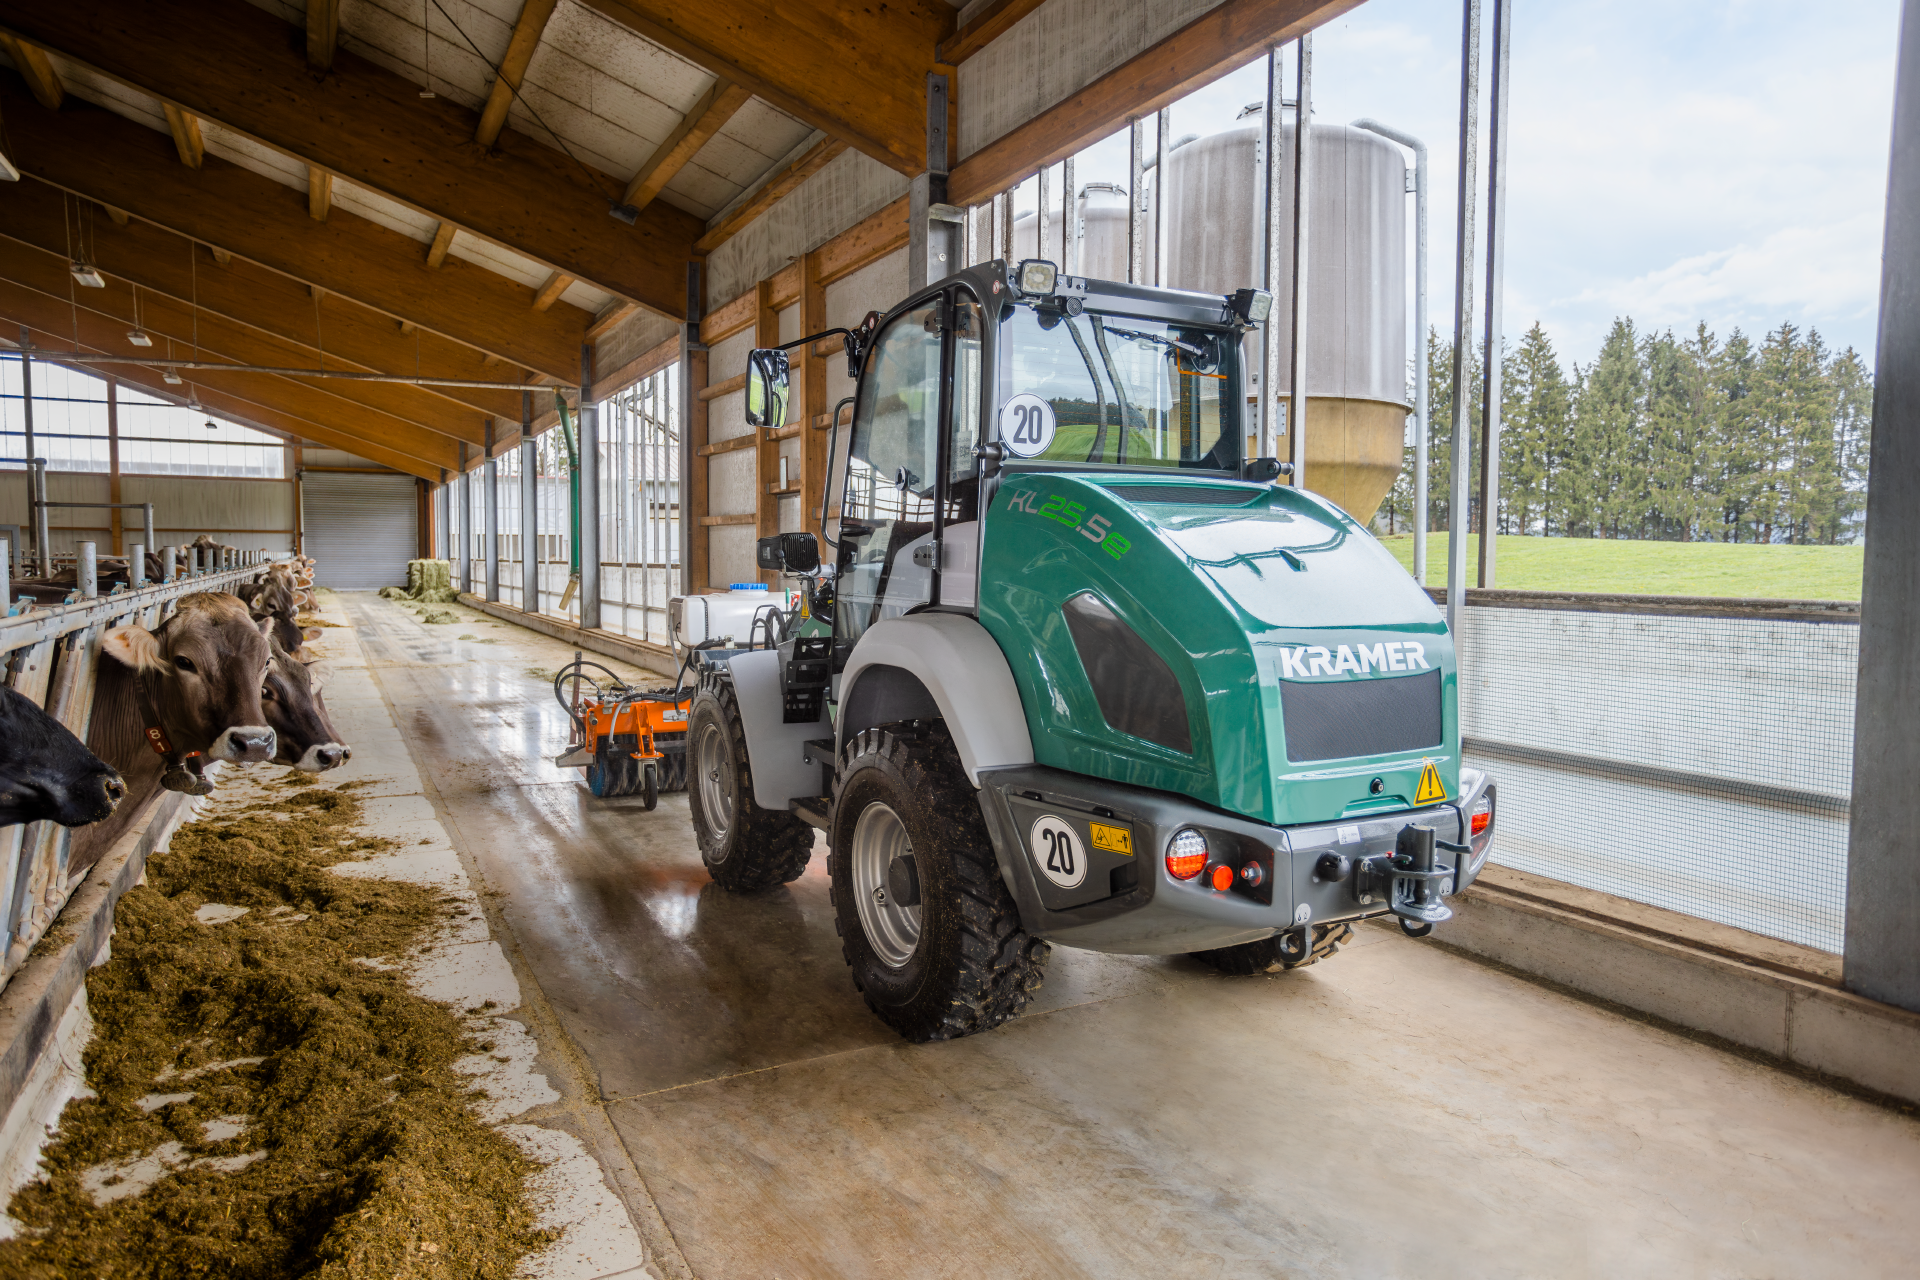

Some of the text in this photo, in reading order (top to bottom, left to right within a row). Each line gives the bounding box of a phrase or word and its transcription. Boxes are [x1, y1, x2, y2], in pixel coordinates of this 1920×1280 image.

[1013, 404, 1043, 444] 20
[1279, 641, 1430, 678] KRAMER
[1042, 828, 1075, 875] 20
